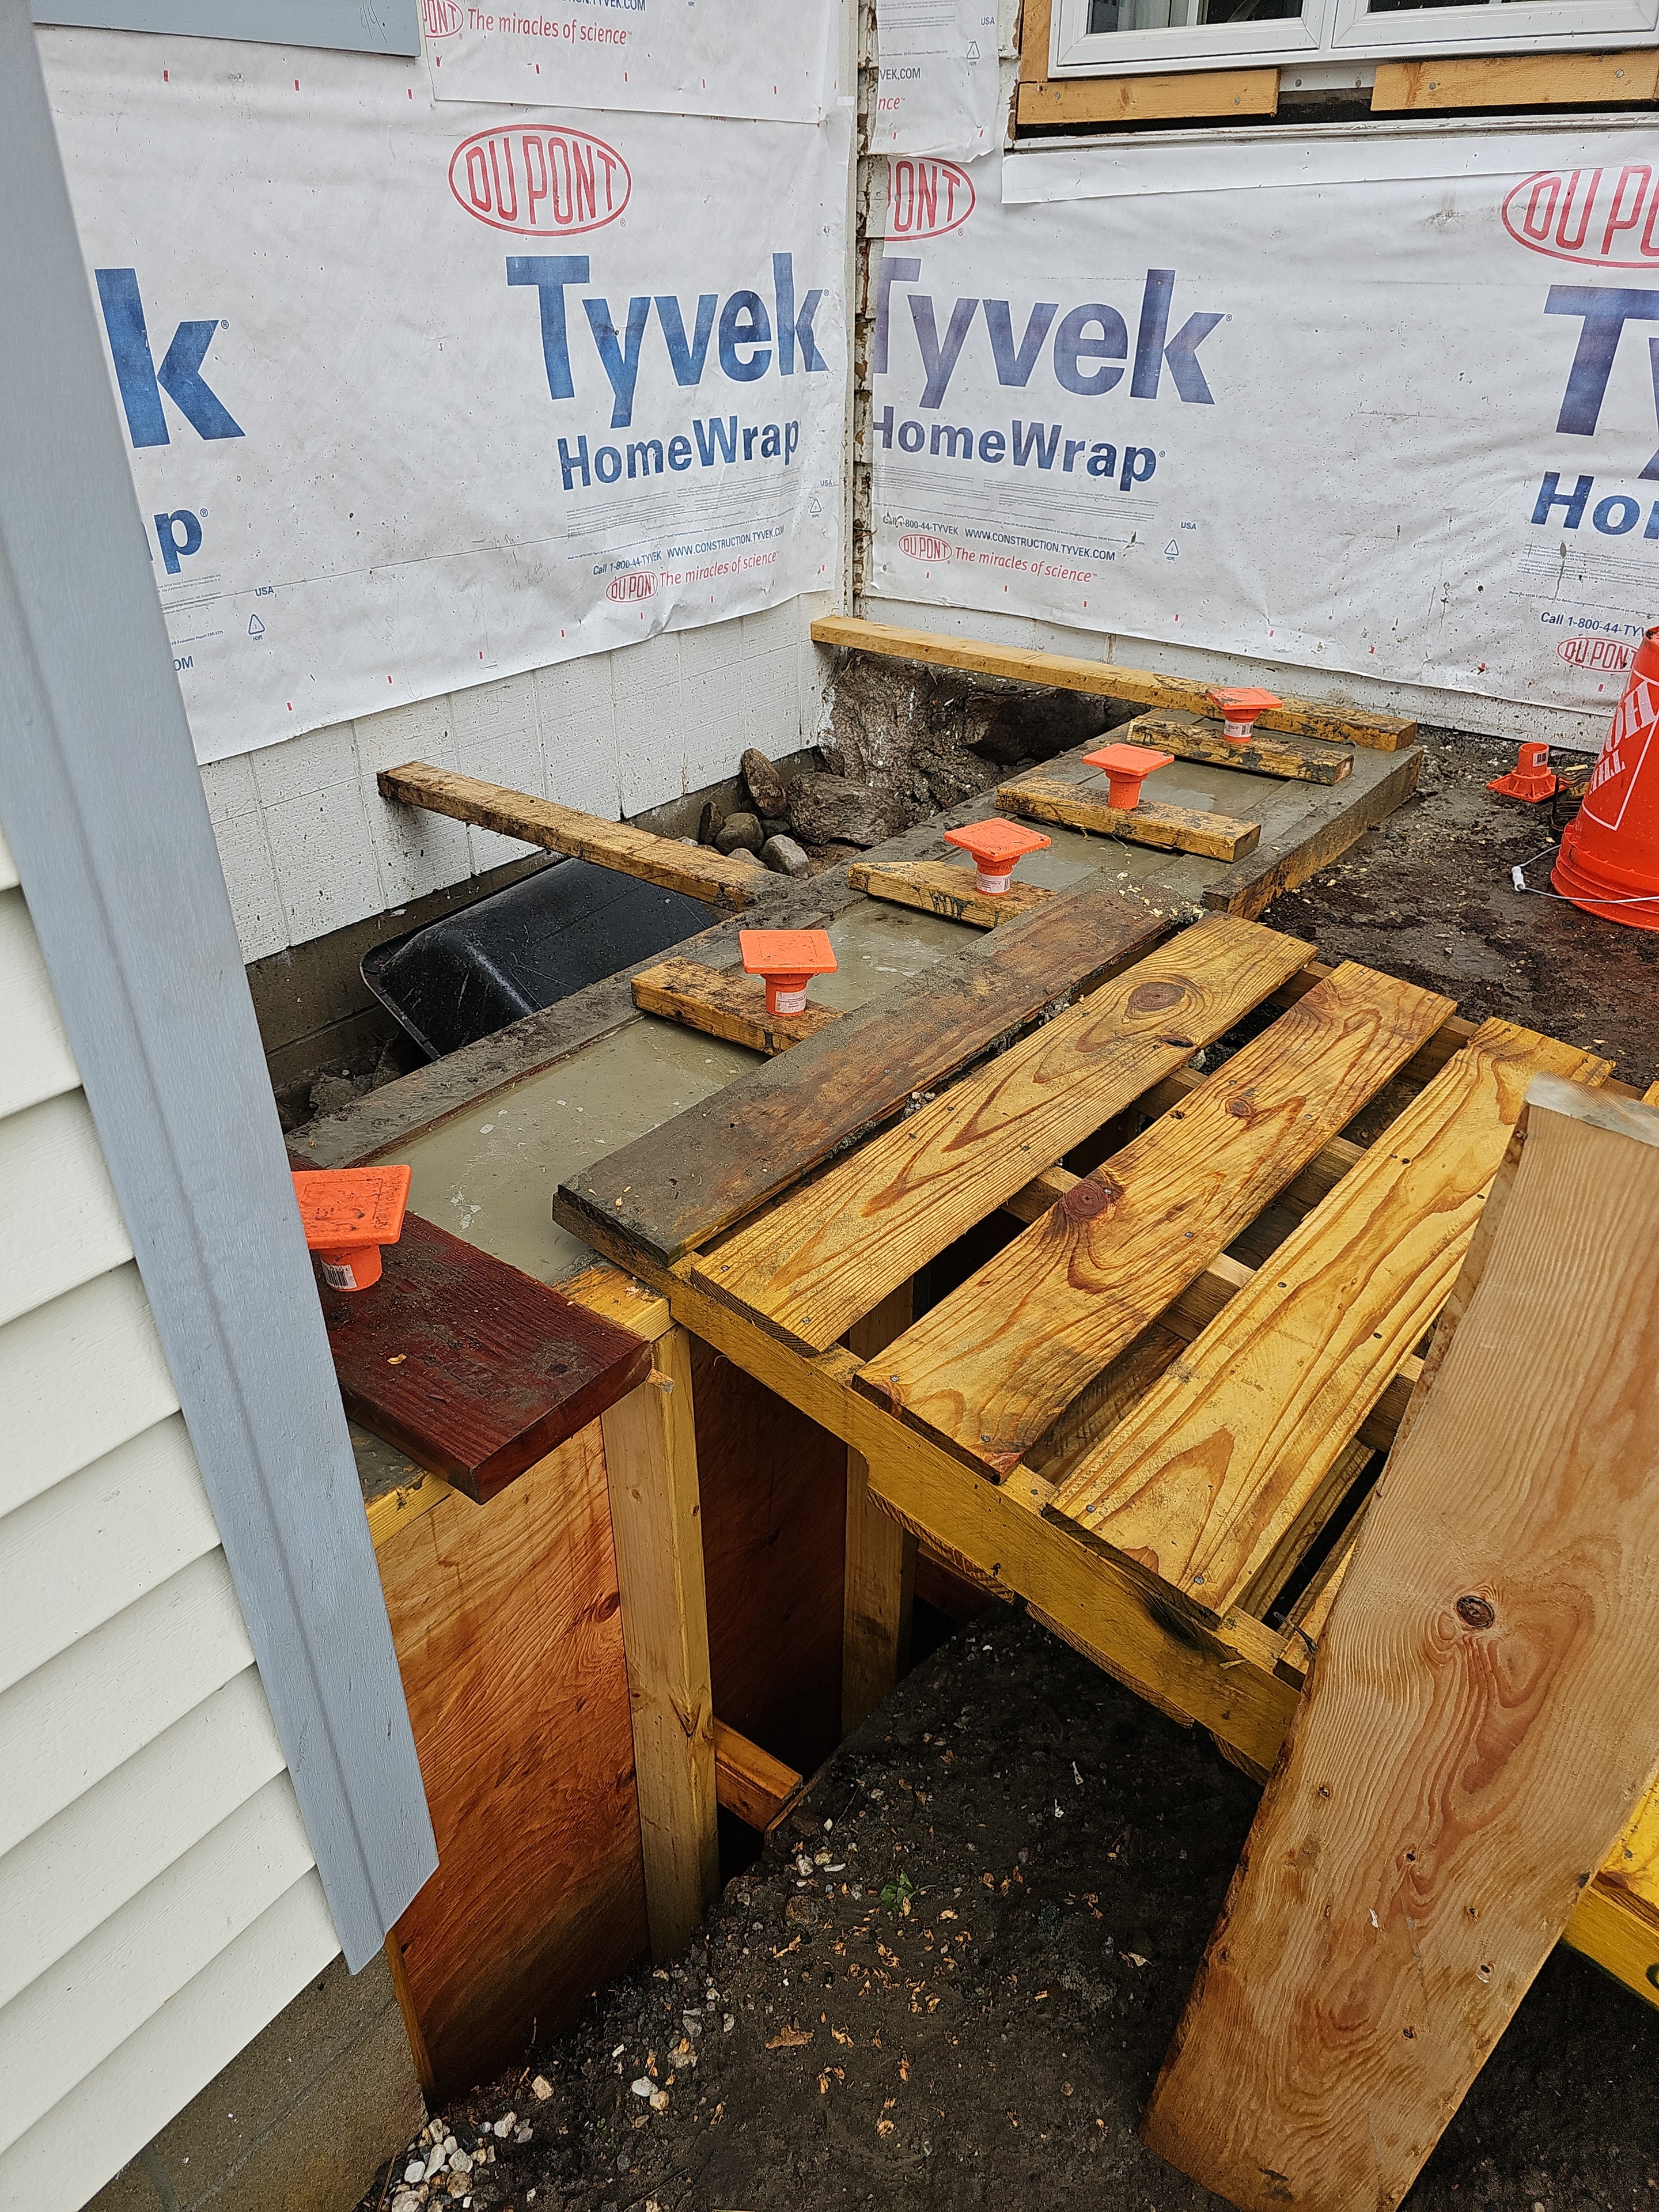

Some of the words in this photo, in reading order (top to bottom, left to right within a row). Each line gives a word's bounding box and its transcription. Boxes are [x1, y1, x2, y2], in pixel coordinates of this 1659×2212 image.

[423, 0, 457, 33] ONT
[468, 9, 494, 31] The
[499, 12, 559, 38] miracles
[563, 19, 577, 44] of
[579, 22, 626, 44] science
[981, 16, 995, 25] USA
[878, 97, 900, 111] nce
[888, 160, 960, 232] ONT
[505, 252, 830, 429] Tyvek
[557, 415, 800, 491] HomeWrap
[1531, 471, 1659, 539] Ho
[142, 509, 202, 574] p
[1181, 521, 1196, 530] USA
[965, 528, 1115, 561] WWW.CONSTRUCTION.TYVEK.COM
[593, 563, 607, 575] Call
[660, 572, 681, 588] The
[685, 561, 728, 584] miracles
[731, 556, 741, 574] of
[743, 551, 777, 569] science
[956, 547, 975, 562] The
[979, 552, 1028, 571] miracles
[1031, 561, 1044, 577] of
[1044, 565, 1092, 582] science
[255, 586, 274, 597] USA
[1541, 612, 1564, 625] Call
